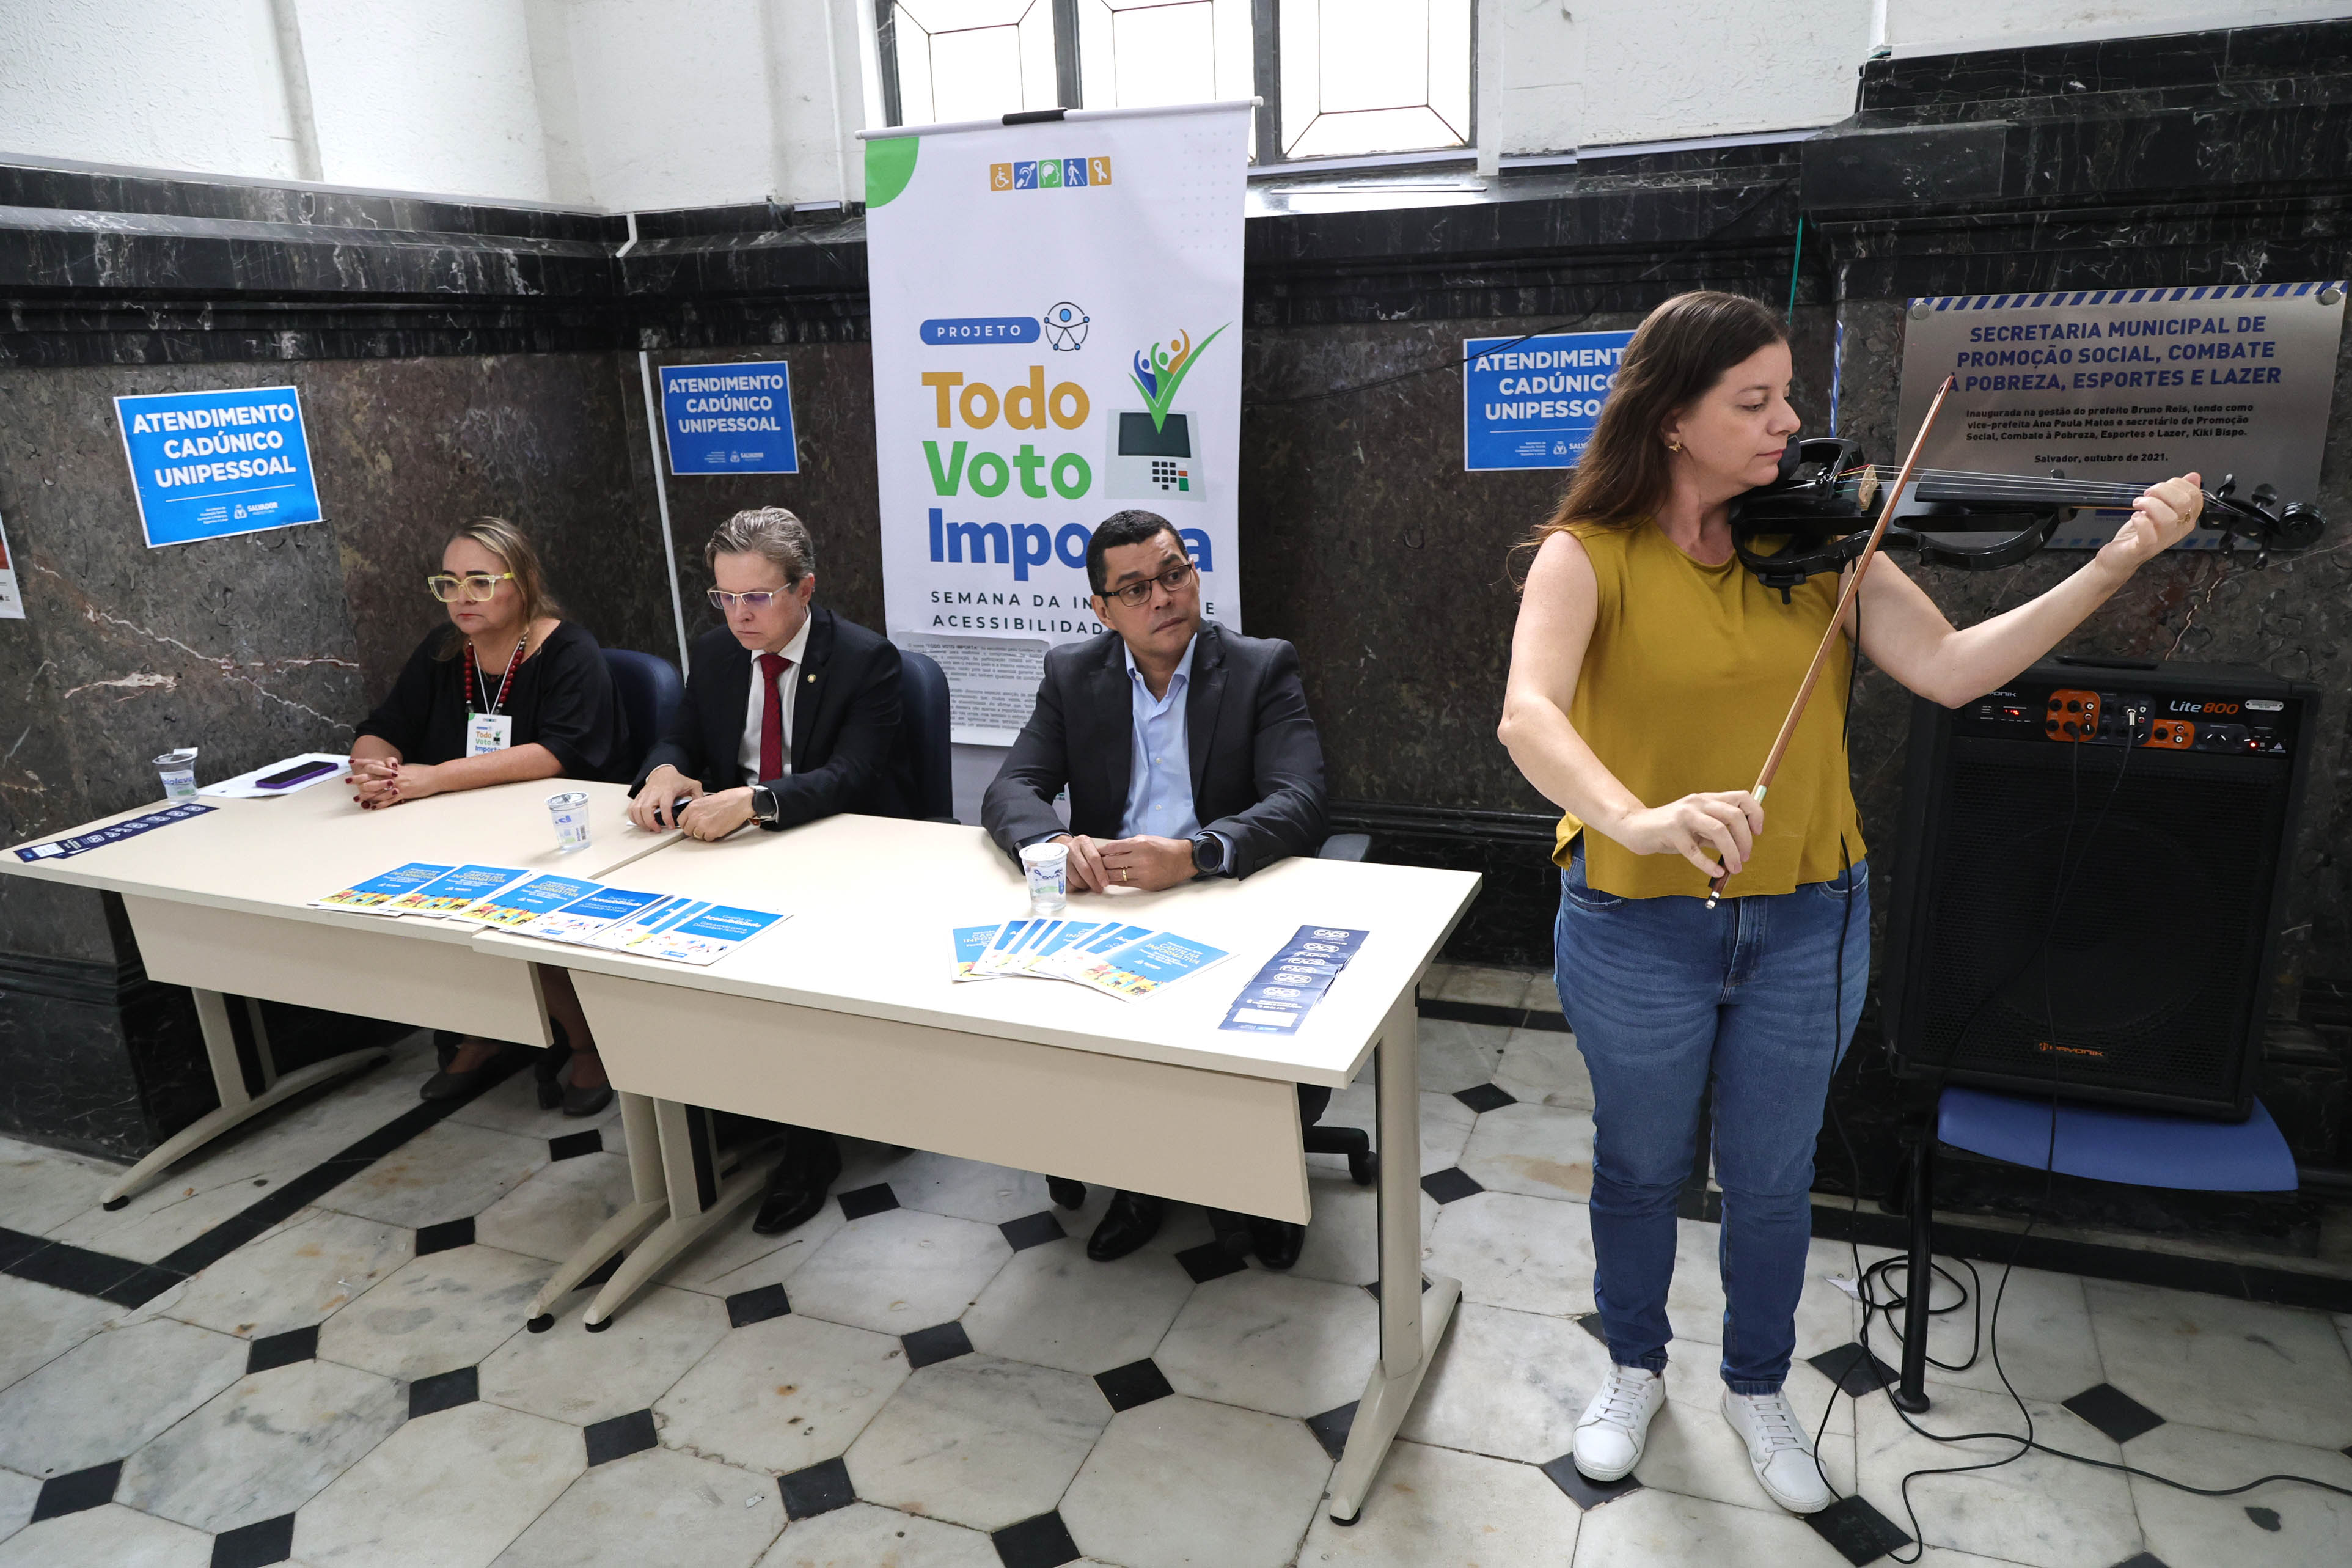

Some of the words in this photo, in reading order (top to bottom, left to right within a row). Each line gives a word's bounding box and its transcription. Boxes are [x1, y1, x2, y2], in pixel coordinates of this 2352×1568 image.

[937, 324, 1022, 338] PROJETO
[1970, 322, 2101, 342] SECRETARIA
[2108, 317, 2230, 337] MUNICIPAL
[2237, 316, 2266, 333] DE
[1474, 348, 1626, 372] ATENDIMENT
[1957, 345, 2072, 369] PROMOÇÃO
[2078, 345, 2161, 364] SOCIAL,
[2168, 341, 2275, 361] COMBATE
[669, 375, 783, 393] ATENDIMENTO
[1965, 373, 2066, 392] POBREZA,
[2073, 369, 2184, 389] ESPORTES
[2191, 369, 2204, 386] E
[2210, 367, 2281, 385] LAZER
[686, 394, 772, 413] CADÚNICO
[921, 365, 1090, 430] Todo
[133, 403, 295, 434] ATENDIMENTO
[1486, 399, 1601, 420] UNIPESSO
[1966, 409, 2021, 419] Inaugurada
[2038, 407, 2071, 417] gestão
[2074, 407, 2086, 416] do
[2088, 406, 2128, 416] prefeito
[2165, 405, 2190, 414] Reis,
[2194, 404, 2222, 412] tendo
[678, 417, 780, 433] UNIPESSOAL
[1968, 420, 2030, 430] vice-prefeita
[2125, 416, 2178, 425] secretário
[2196, 416, 2249, 426] Promoção
[164, 430, 284, 458] CADÚNICO
[1966, 432, 1998, 441] Social,
[2054, 431, 2098, 440] Pobreza,
[2101, 431, 2145, 439] Esportes
[2157, 430, 2189, 438] Lazer,
[2215, 428, 2247, 438] Bispo.
[2034, 455, 2081, 464] Salvador,
[2141, 453, 2168, 461] 2021.
[155, 455, 296, 488] UNIPESSOAL
[921, 441, 1091, 499] Voto
[928, 508, 1213, 581] Impoa
[931, 591, 1020, 606] SEMANA
[1033, 595, 1060, 607] DA
[932, 615, 1102, 635] ACESSIBILIDAD
[1145, 943, 1200, 965] INFORMATIVA
[1160, 943, 1200, 958] CARTILHA
